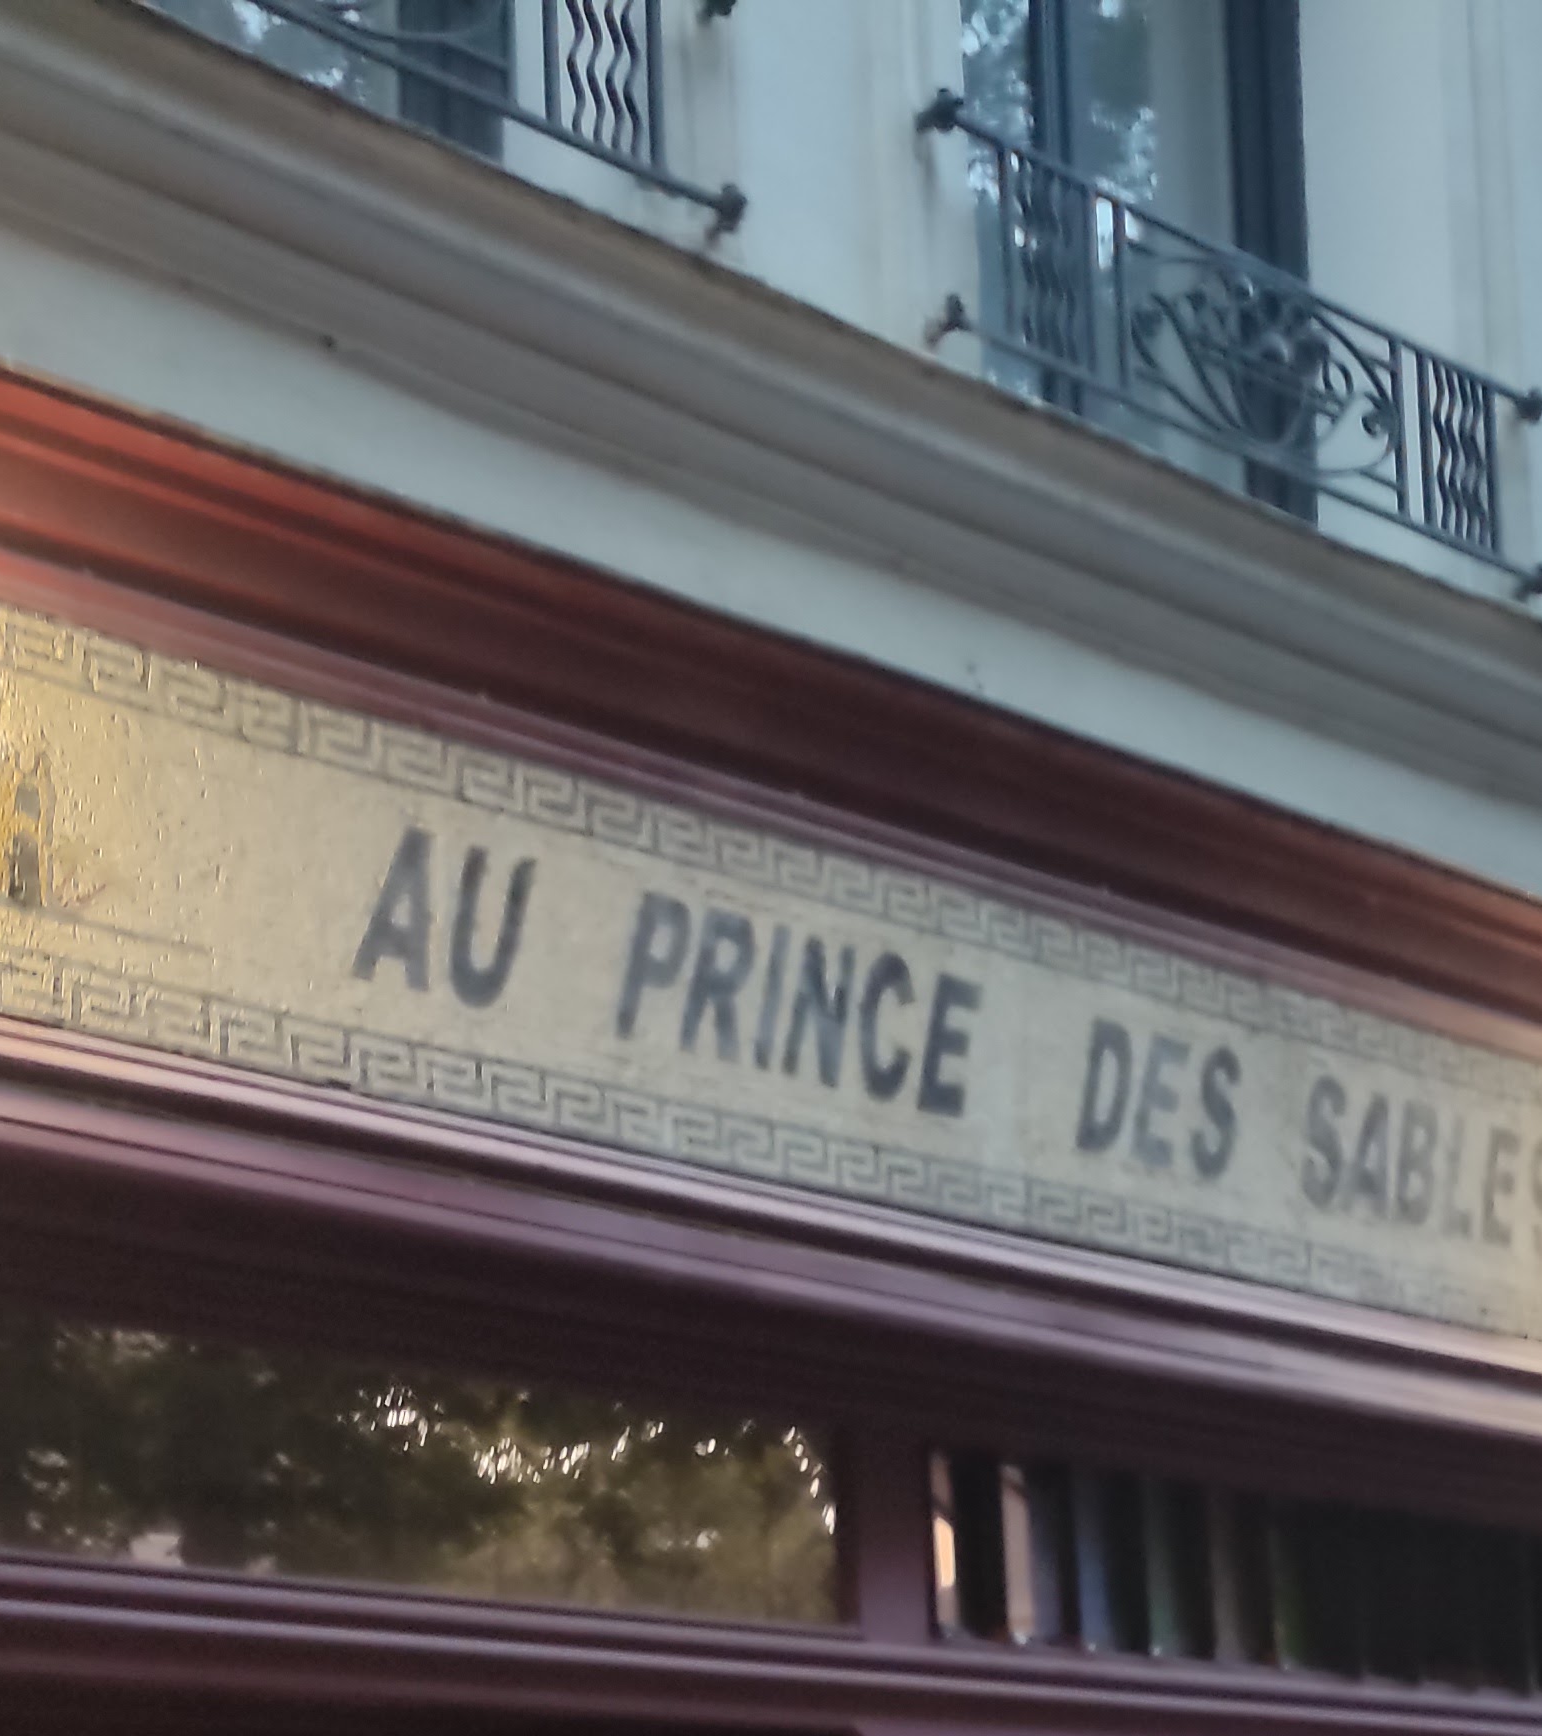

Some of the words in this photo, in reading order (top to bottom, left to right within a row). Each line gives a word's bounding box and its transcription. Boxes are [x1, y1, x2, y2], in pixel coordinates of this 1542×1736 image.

[352, 826, 536, 1008] AU
[616, 891, 982, 1118] PRINCE
[1075, 1018, 1241, 1181] DES
